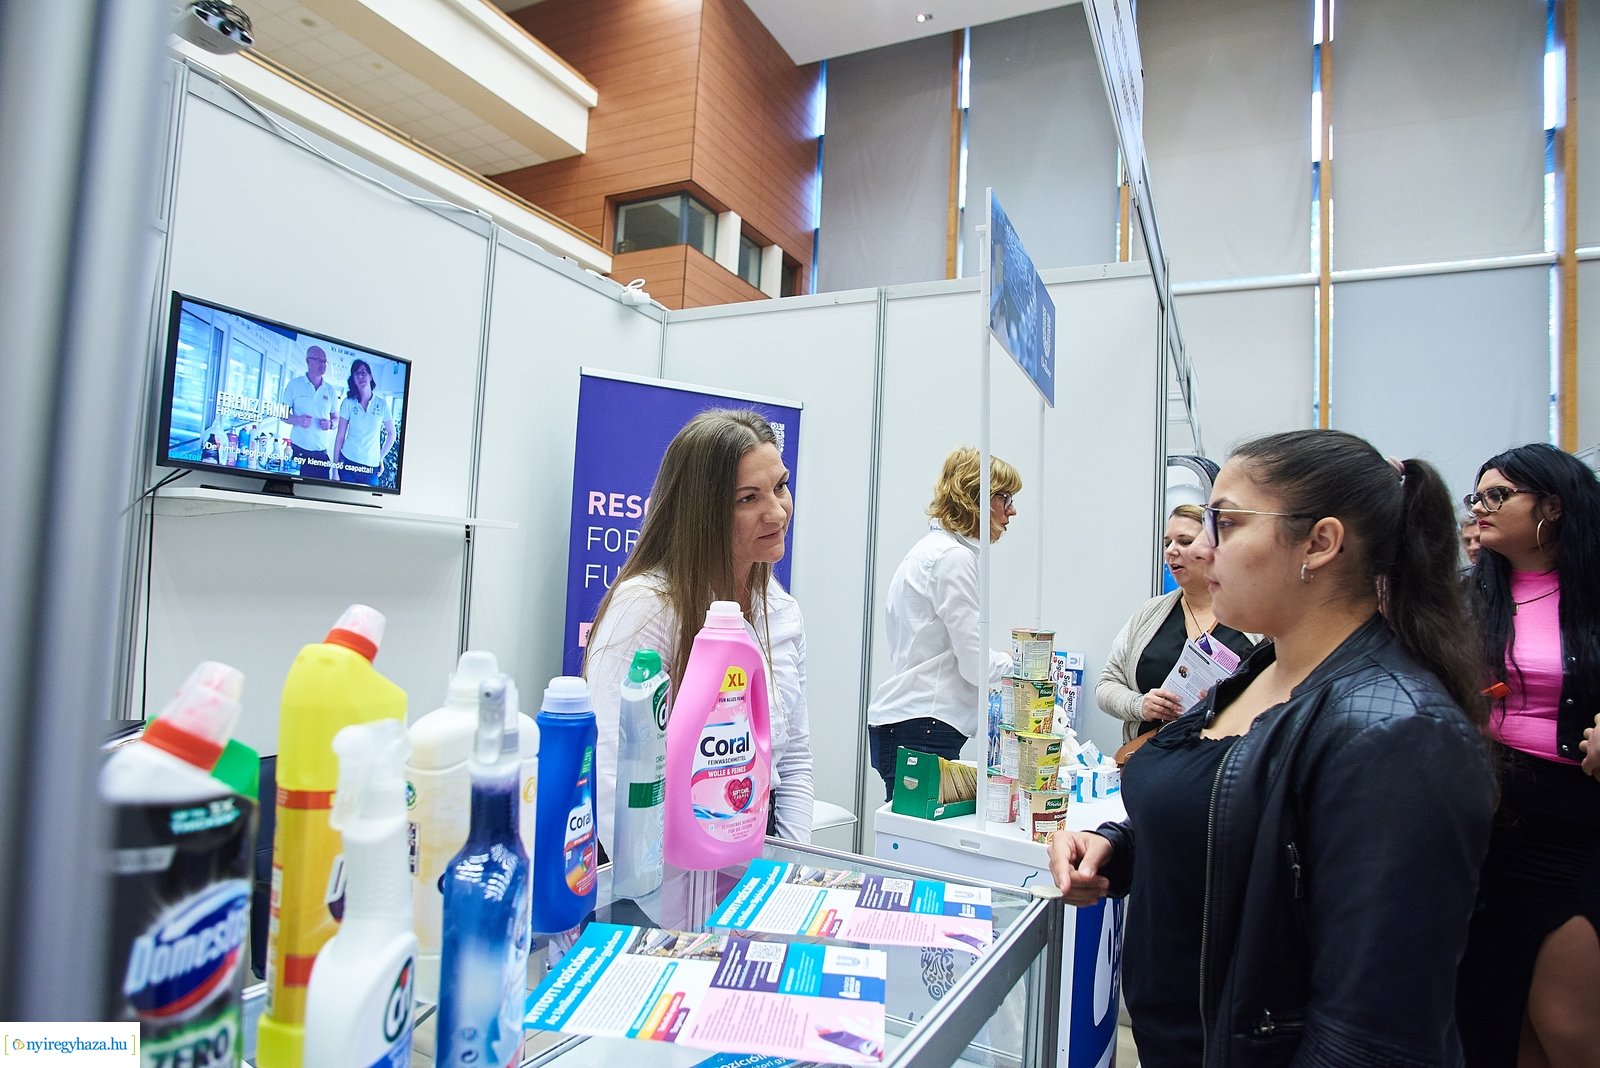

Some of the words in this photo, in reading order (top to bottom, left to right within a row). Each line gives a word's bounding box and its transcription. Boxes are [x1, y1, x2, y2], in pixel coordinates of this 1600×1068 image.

[217, 391, 260, 413] FERENCZ
[261, 400, 289, 419] FANNI
[294, 456, 307, 465] egy
[307, 458, 343, 470] kiemelkedő
[587, 526, 640, 553] FOR
[585, 564, 621, 589] FU
[728, 673, 745, 688] XL
[1067, 690, 1076, 713] Signal
[700, 732, 750, 758] Coral
[707, 756, 747, 766] FEINWASCHMITTEL
[708, 769, 727, 778] WOLLE
[731, 766, 746, 775] FEINES
